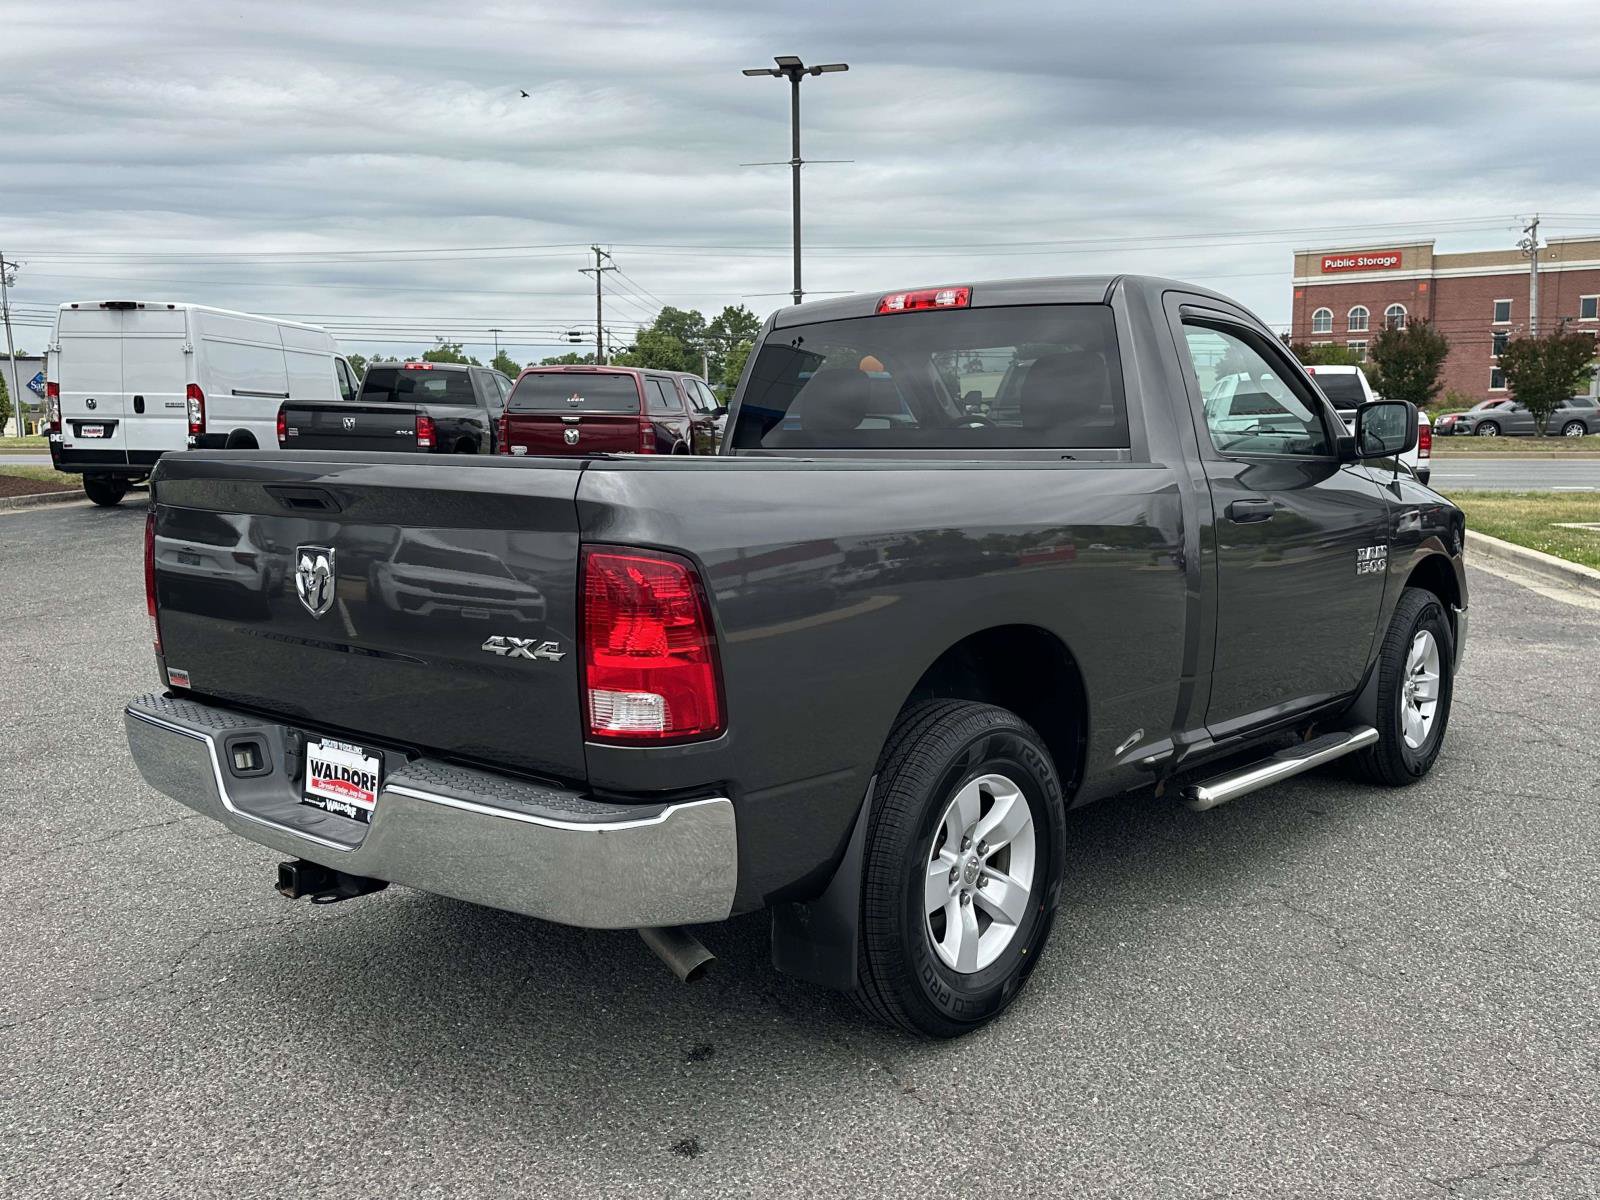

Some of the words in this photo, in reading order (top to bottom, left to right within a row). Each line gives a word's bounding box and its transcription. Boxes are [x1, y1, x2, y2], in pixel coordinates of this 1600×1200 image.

[1325, 258, 1356, 268] Public
[1357, 256, 1398, 267] Storage
[481, 635, 567, 662] 4X4
[310, 759, 377, 792] WALDORF
[326, 799, 357, 818] WALDORF
